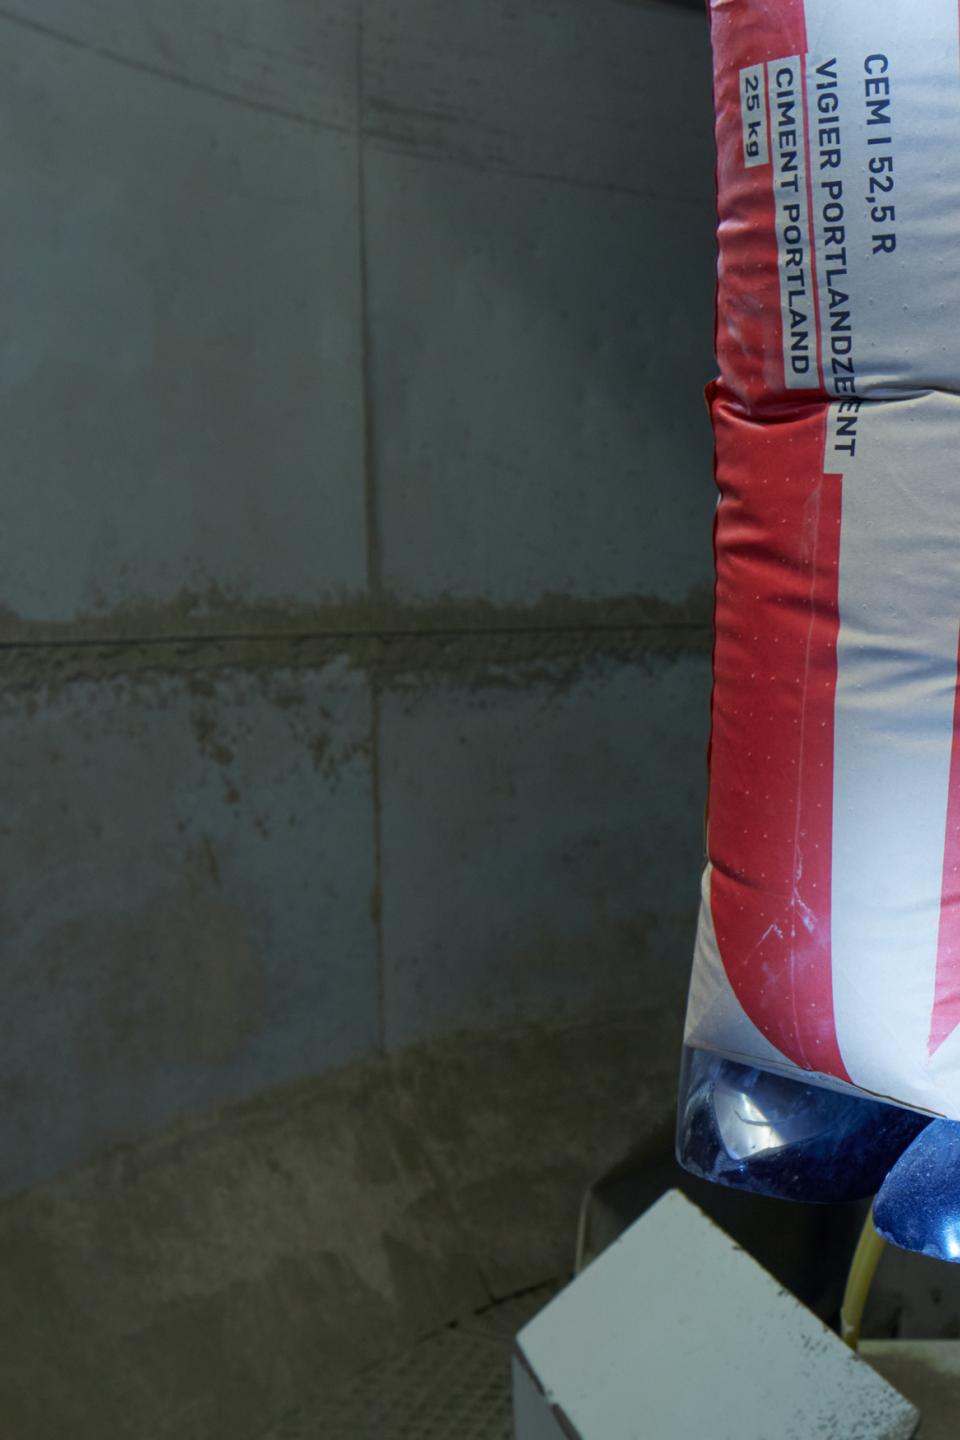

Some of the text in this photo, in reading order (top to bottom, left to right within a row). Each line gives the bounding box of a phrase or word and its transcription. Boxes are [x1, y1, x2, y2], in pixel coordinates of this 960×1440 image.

[744, 75, 763, 157] 25 kg
[815, 58, 842, 170] VIGIER
[862, 53, 892, 125] CEM
[774, 67, 810, 375] CIMENT PORTLAND
[865, 157, 896, 222] 52,5
[871, 233, 897, 255] R
